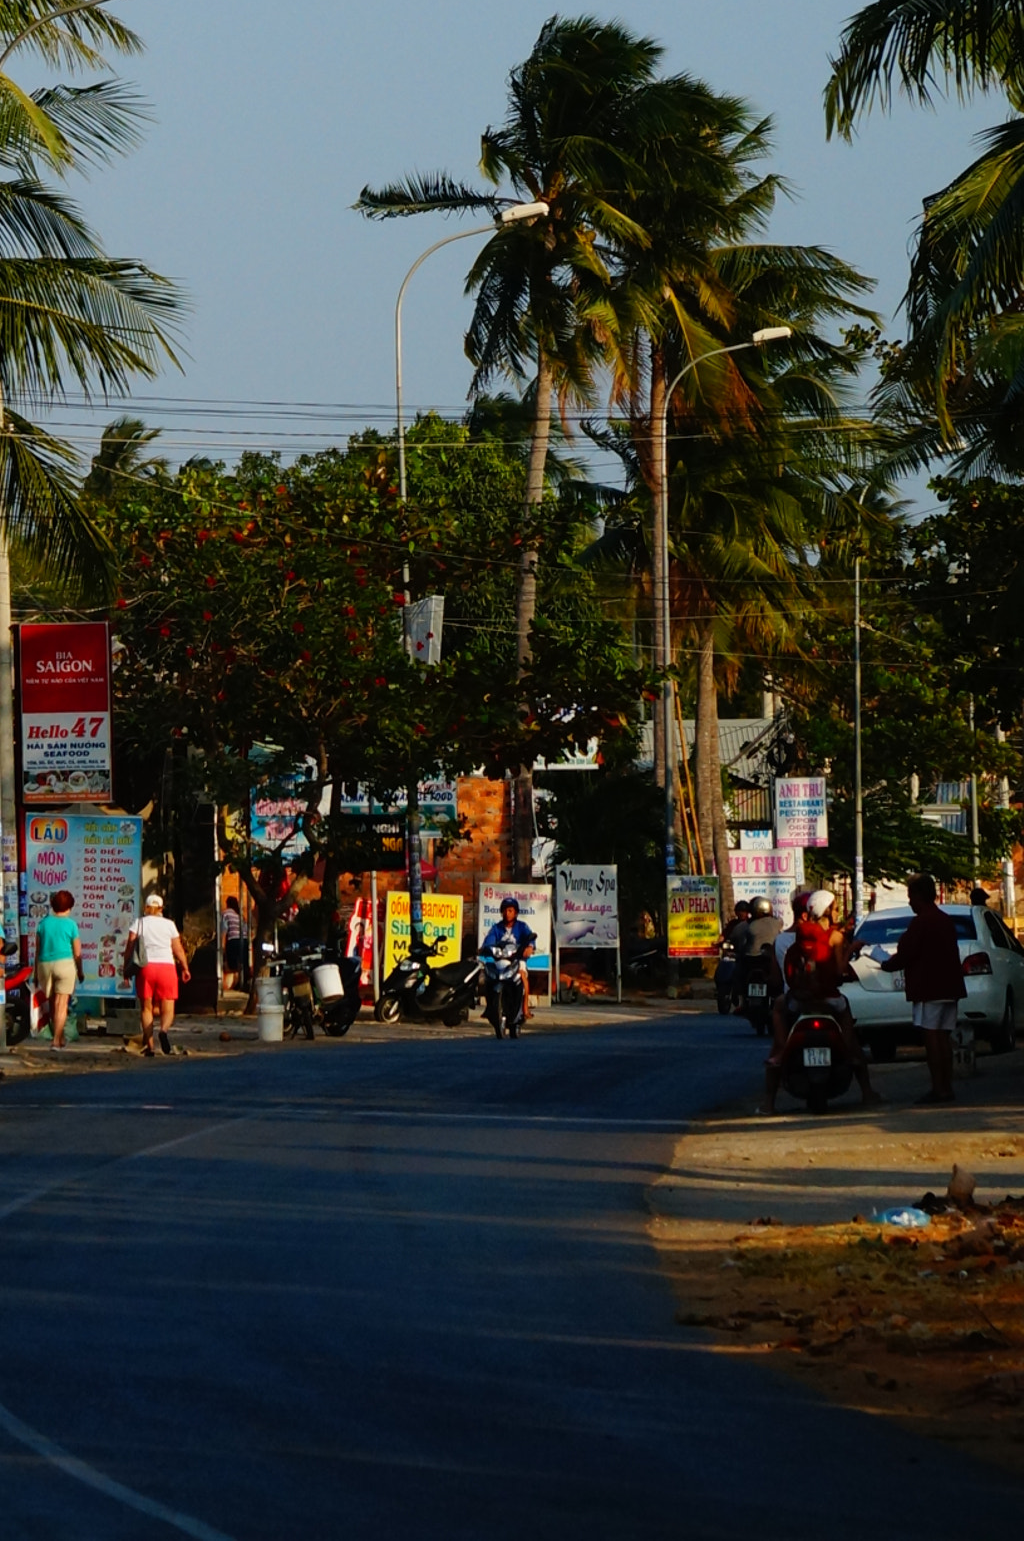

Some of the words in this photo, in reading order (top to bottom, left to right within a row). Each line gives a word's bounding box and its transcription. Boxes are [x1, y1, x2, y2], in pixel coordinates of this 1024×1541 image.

[56, 651, 73, 660] BIA
[36, 660, 93, 673] SAIGON
[27, 725, 68, 739] Hello
[71, 717, 104, 738] 47
[44, 750, 90, 758] SEAFOOD
[779, 783, 800, 798] ANH
[802, 779, 824, 797] THƯ
[779, 799, 824, 807] RESTAURANT
[779, 809, 824, 817] РЕСТОРАН
[37, 848, 64, 866] MÓN
[752, 852, 791, 873] THƯ
[33, 868, 68, 886] NƯỚNG
[596, 870, 615, 896] Spa
[483, 887, 493, 899] 49
[671, 897, 685, 913] AN
[689, 892, 716, 913] PHÁT
[422, 903, 458, 919] валюты
[423, 922, 455, 938] Card
